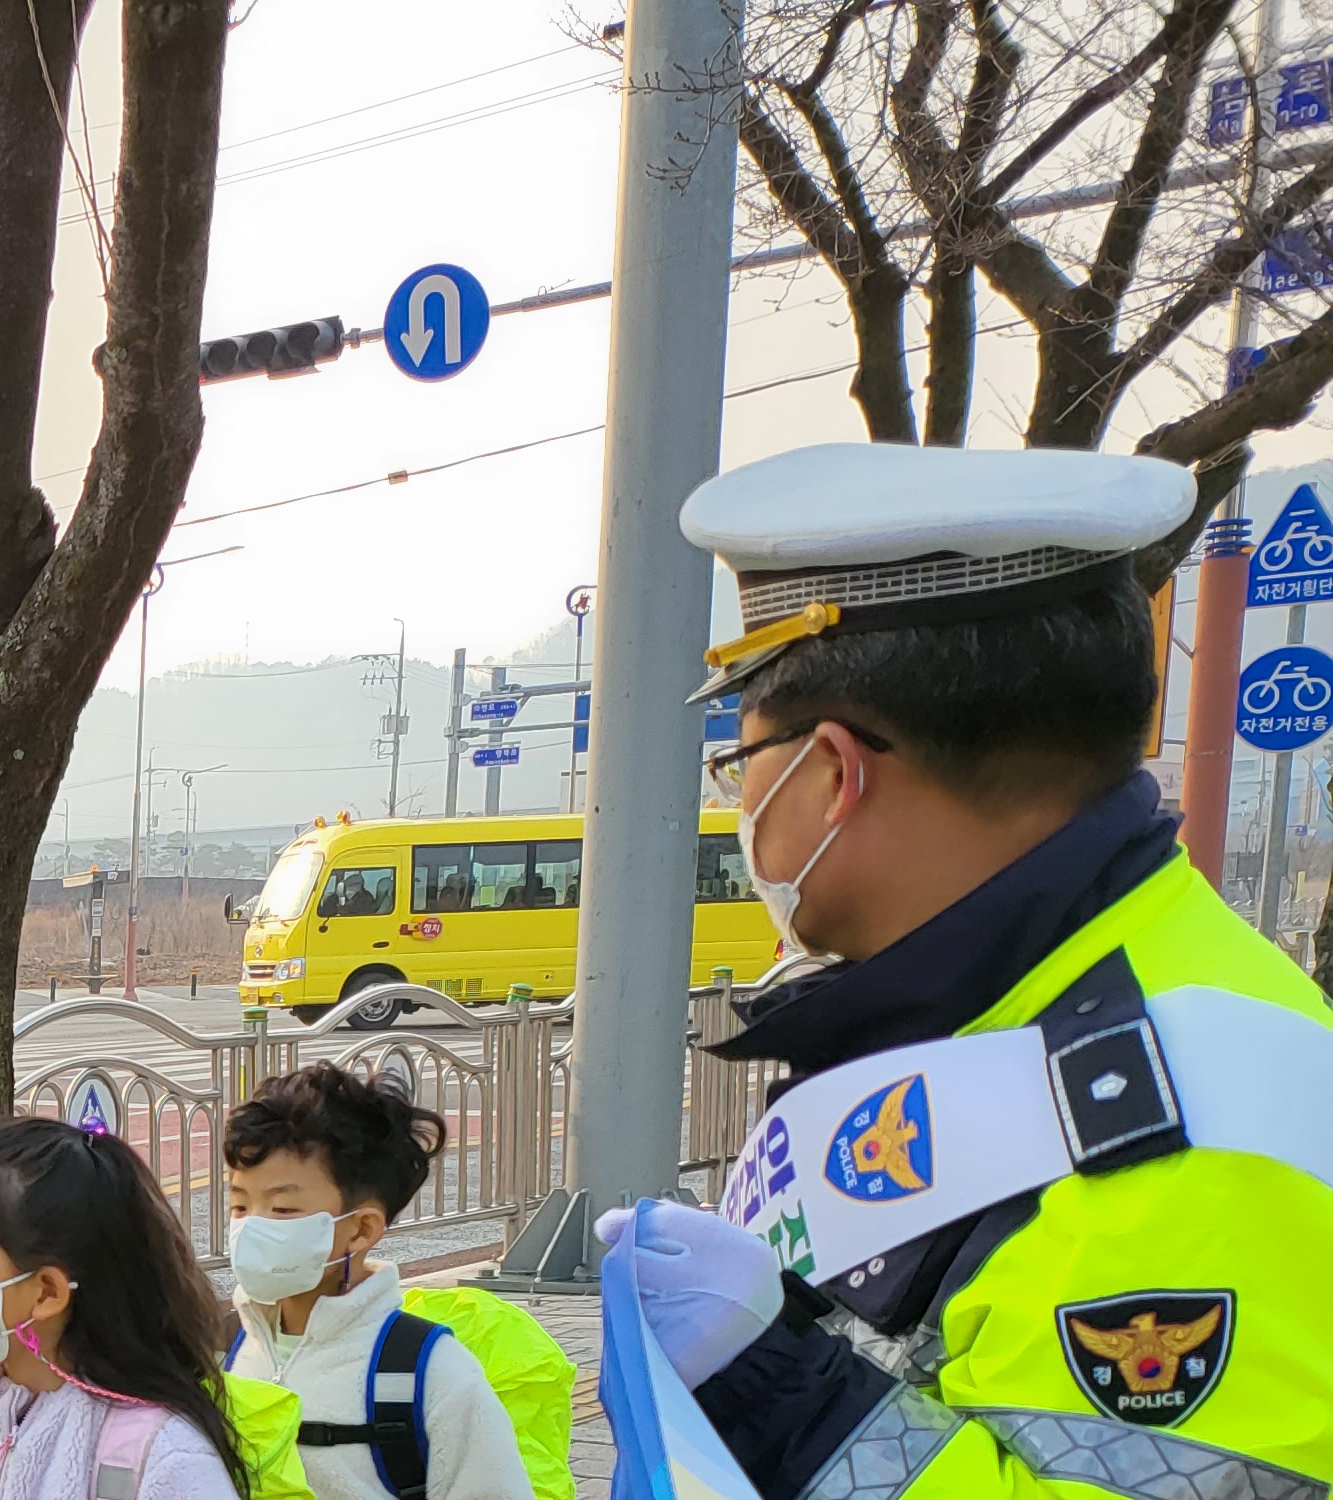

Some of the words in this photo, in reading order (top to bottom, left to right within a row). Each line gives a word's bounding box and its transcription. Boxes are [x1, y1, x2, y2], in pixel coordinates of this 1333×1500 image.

[1254, 577, 1333, 602] 자전거횡단
[1240, 715, 1329, 734] 자전거전용
[835, 1135, 858, 1191] POLICE
[1092, 1364, 1112, 1386] 경
[1117, 1390, 1186, 1411] POLICE
